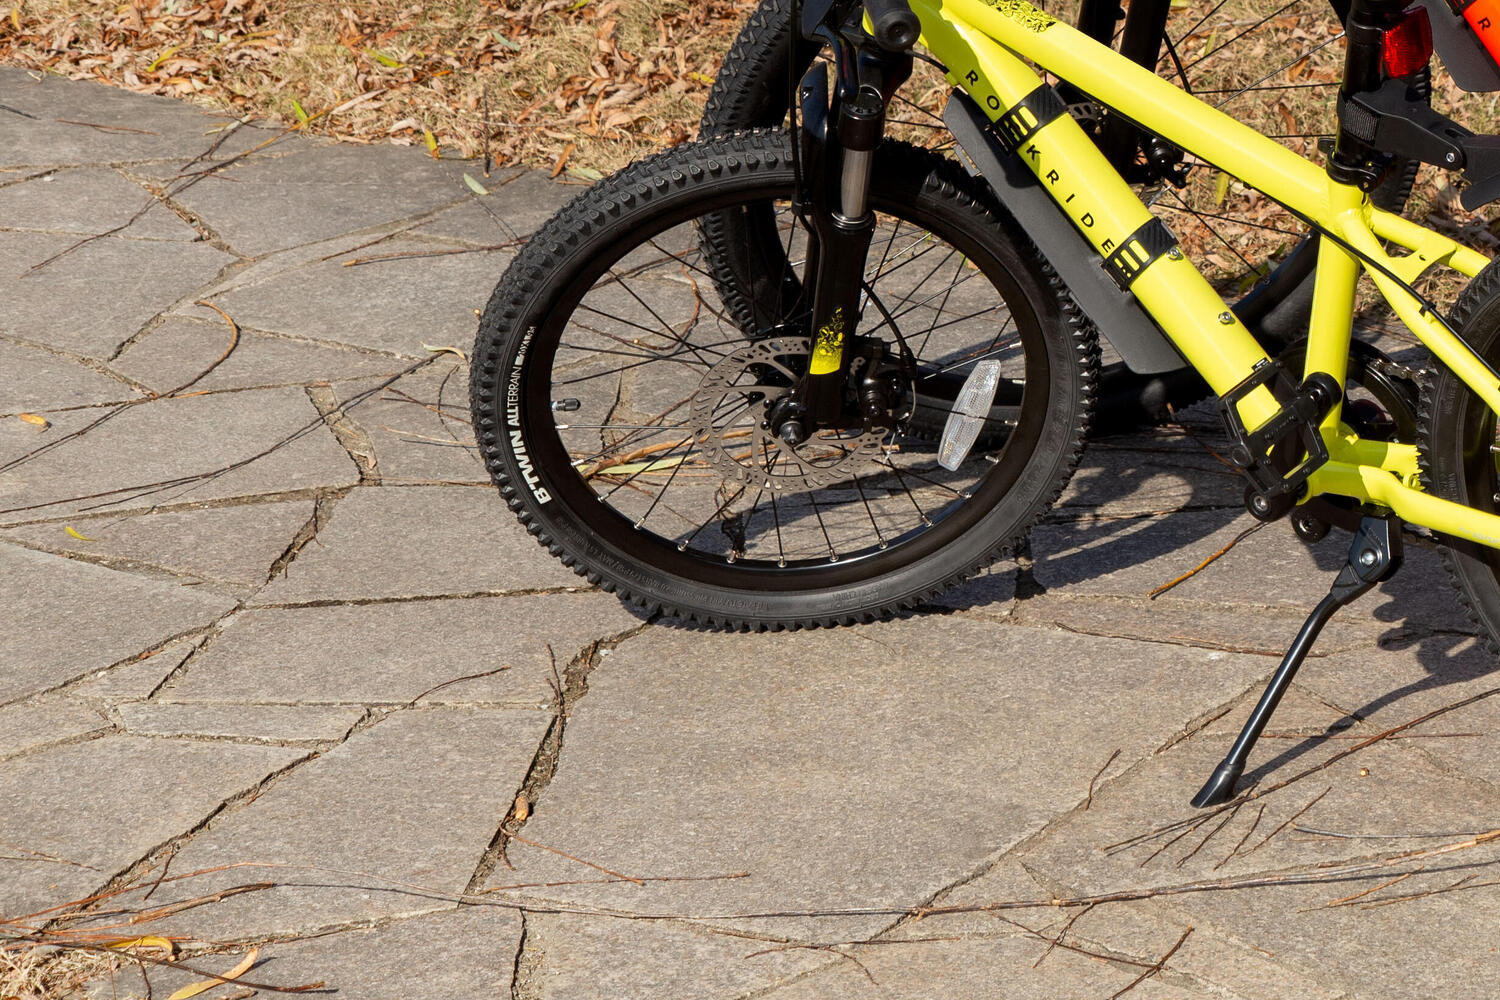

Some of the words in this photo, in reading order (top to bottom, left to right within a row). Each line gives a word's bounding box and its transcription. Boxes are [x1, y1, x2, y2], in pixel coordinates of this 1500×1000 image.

[965, 69, 1130, 280] ROKRIDE
[507, 366, 522, 427] ALLTERRAIN
[509, 430, 552, 505] B'TWIN
